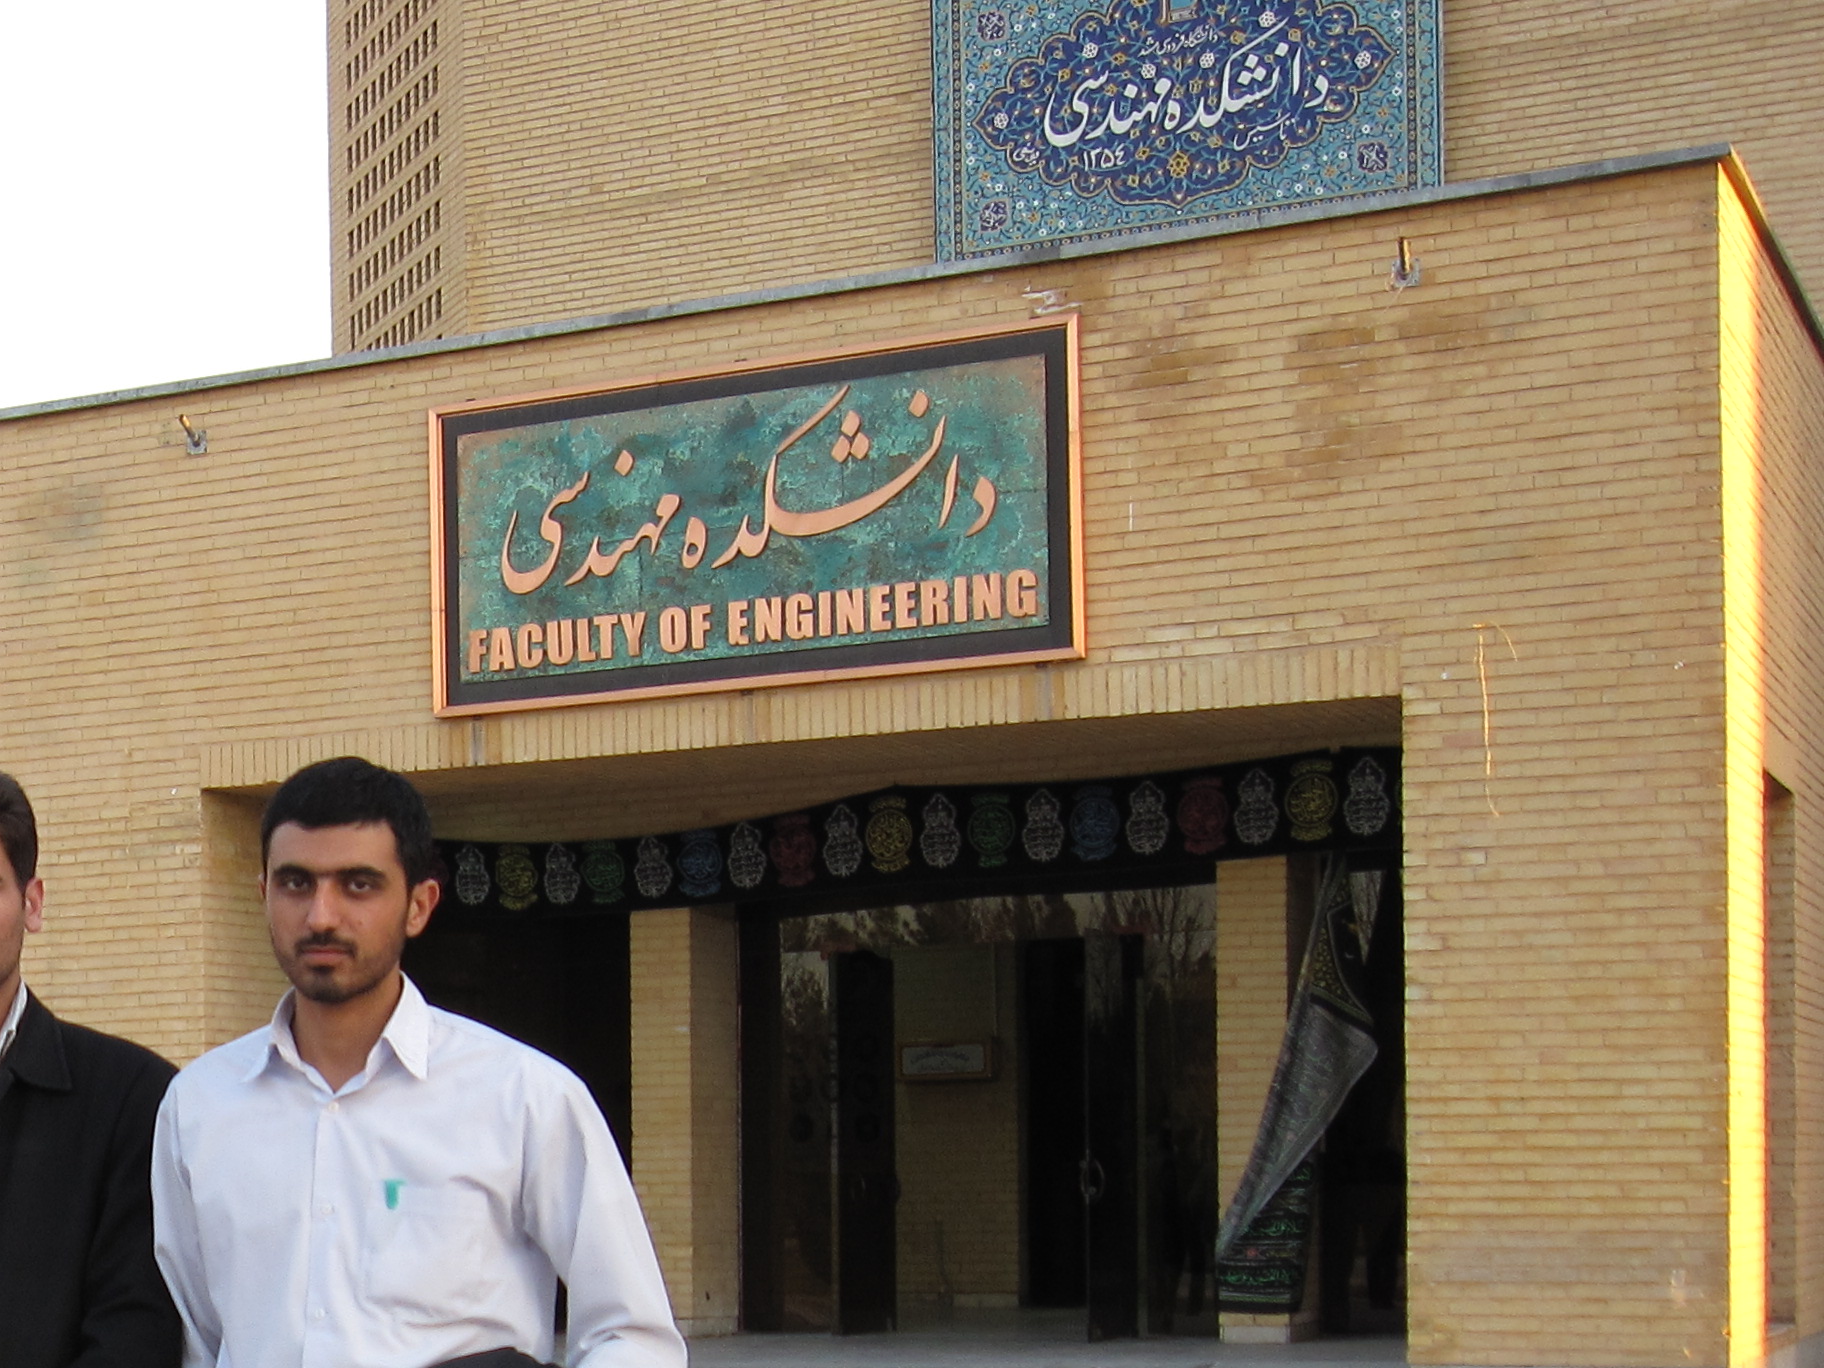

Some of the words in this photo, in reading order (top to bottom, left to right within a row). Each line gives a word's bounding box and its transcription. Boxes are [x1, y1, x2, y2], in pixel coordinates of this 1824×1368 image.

[1043, 68, 1173, 148] مهندسی
[1165, 18, 1330, 133] دانشکده
[500, 450, 682, 596] مهندسی
[680, 384, 997, 570] دانشکده
[467, 610, 647, 675] FACULTY
[658, 604, 713, 654] OF
[727, 568, 1041, 647] ENGINEERING
